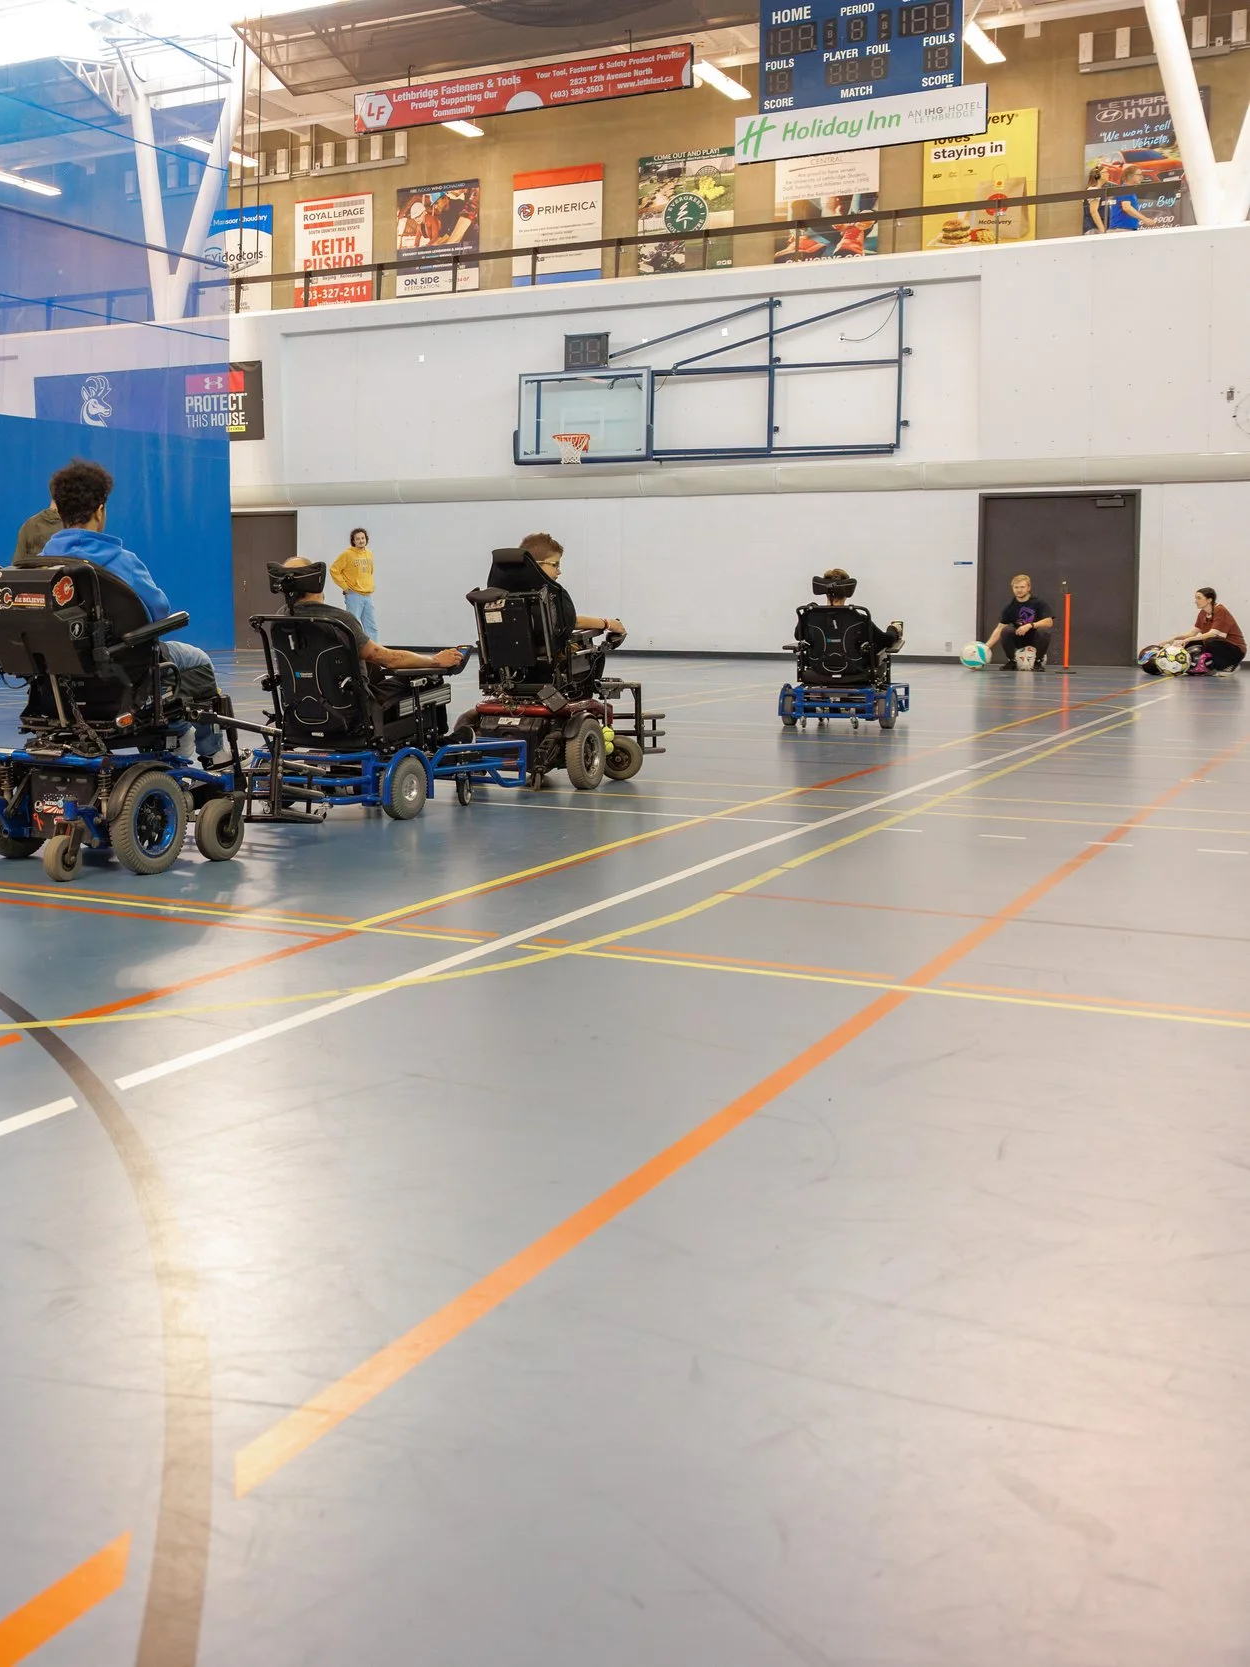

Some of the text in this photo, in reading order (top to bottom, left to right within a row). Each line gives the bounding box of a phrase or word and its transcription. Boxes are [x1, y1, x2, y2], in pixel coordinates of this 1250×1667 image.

[772, 5, 812, 25] HOME
[840, 2, 875, 17] PERIOD
[923, 33, 956, 47] FOULS
[823, 43, 892, 62] PLAYER FOUL
[536, 51, 686, 80] Your Tool, Fastener & Safety Product Provider
[765, 58, 795, 72] FOULS
[569, 67, 654, 86] 2825 12th Avenue North
[921, 73, 955, 88] SCORE
[392, 74, 522, 103] Lethbridge Fasteners & Tools
[550, 89, 569, 100] (403)
[616, 75, 674, 90] www.lethfast.ca
[840, 85, 873, 99] MATCH
[410, 90, 499, 110] Proudly Supporting Our
[764, 97, 794, 110] SCORE
[432, 105, 476, 118] Community
[908, 108, 922, 119] AN
[948, 101, 983, 112] HOTEL
[914, 110, 976, 124] LETHBRIDGE
[782, 110, 901, 142] Holiday Inn
[1153, 119, 1172, 133] sell
[1132, 134, 1170, 149] Vehicle,
[653, 153, 672, 162] COME
[672, 151, 687, 160] OUT
[687, 149, 702, 158] AND
[702, 147, 720, 156] PLAY!
[933, 142, 1004, 161] staying in
[809, 156, 844, 166] CENTRAL
[537, 201, 597, 216] PRIMERICA
[667, 195, 705, 211] EVERGREEN
[303, 210, 332, 222] ROYAL
[311, 236, 356, 256] KEITH
[404, 278, 418, 287] ON
[404, 284, 440, 292] RESTORATION
[185, 392, 246, 414] PROTECT
[185, 411, 249, 428] THIS HOUSE.
